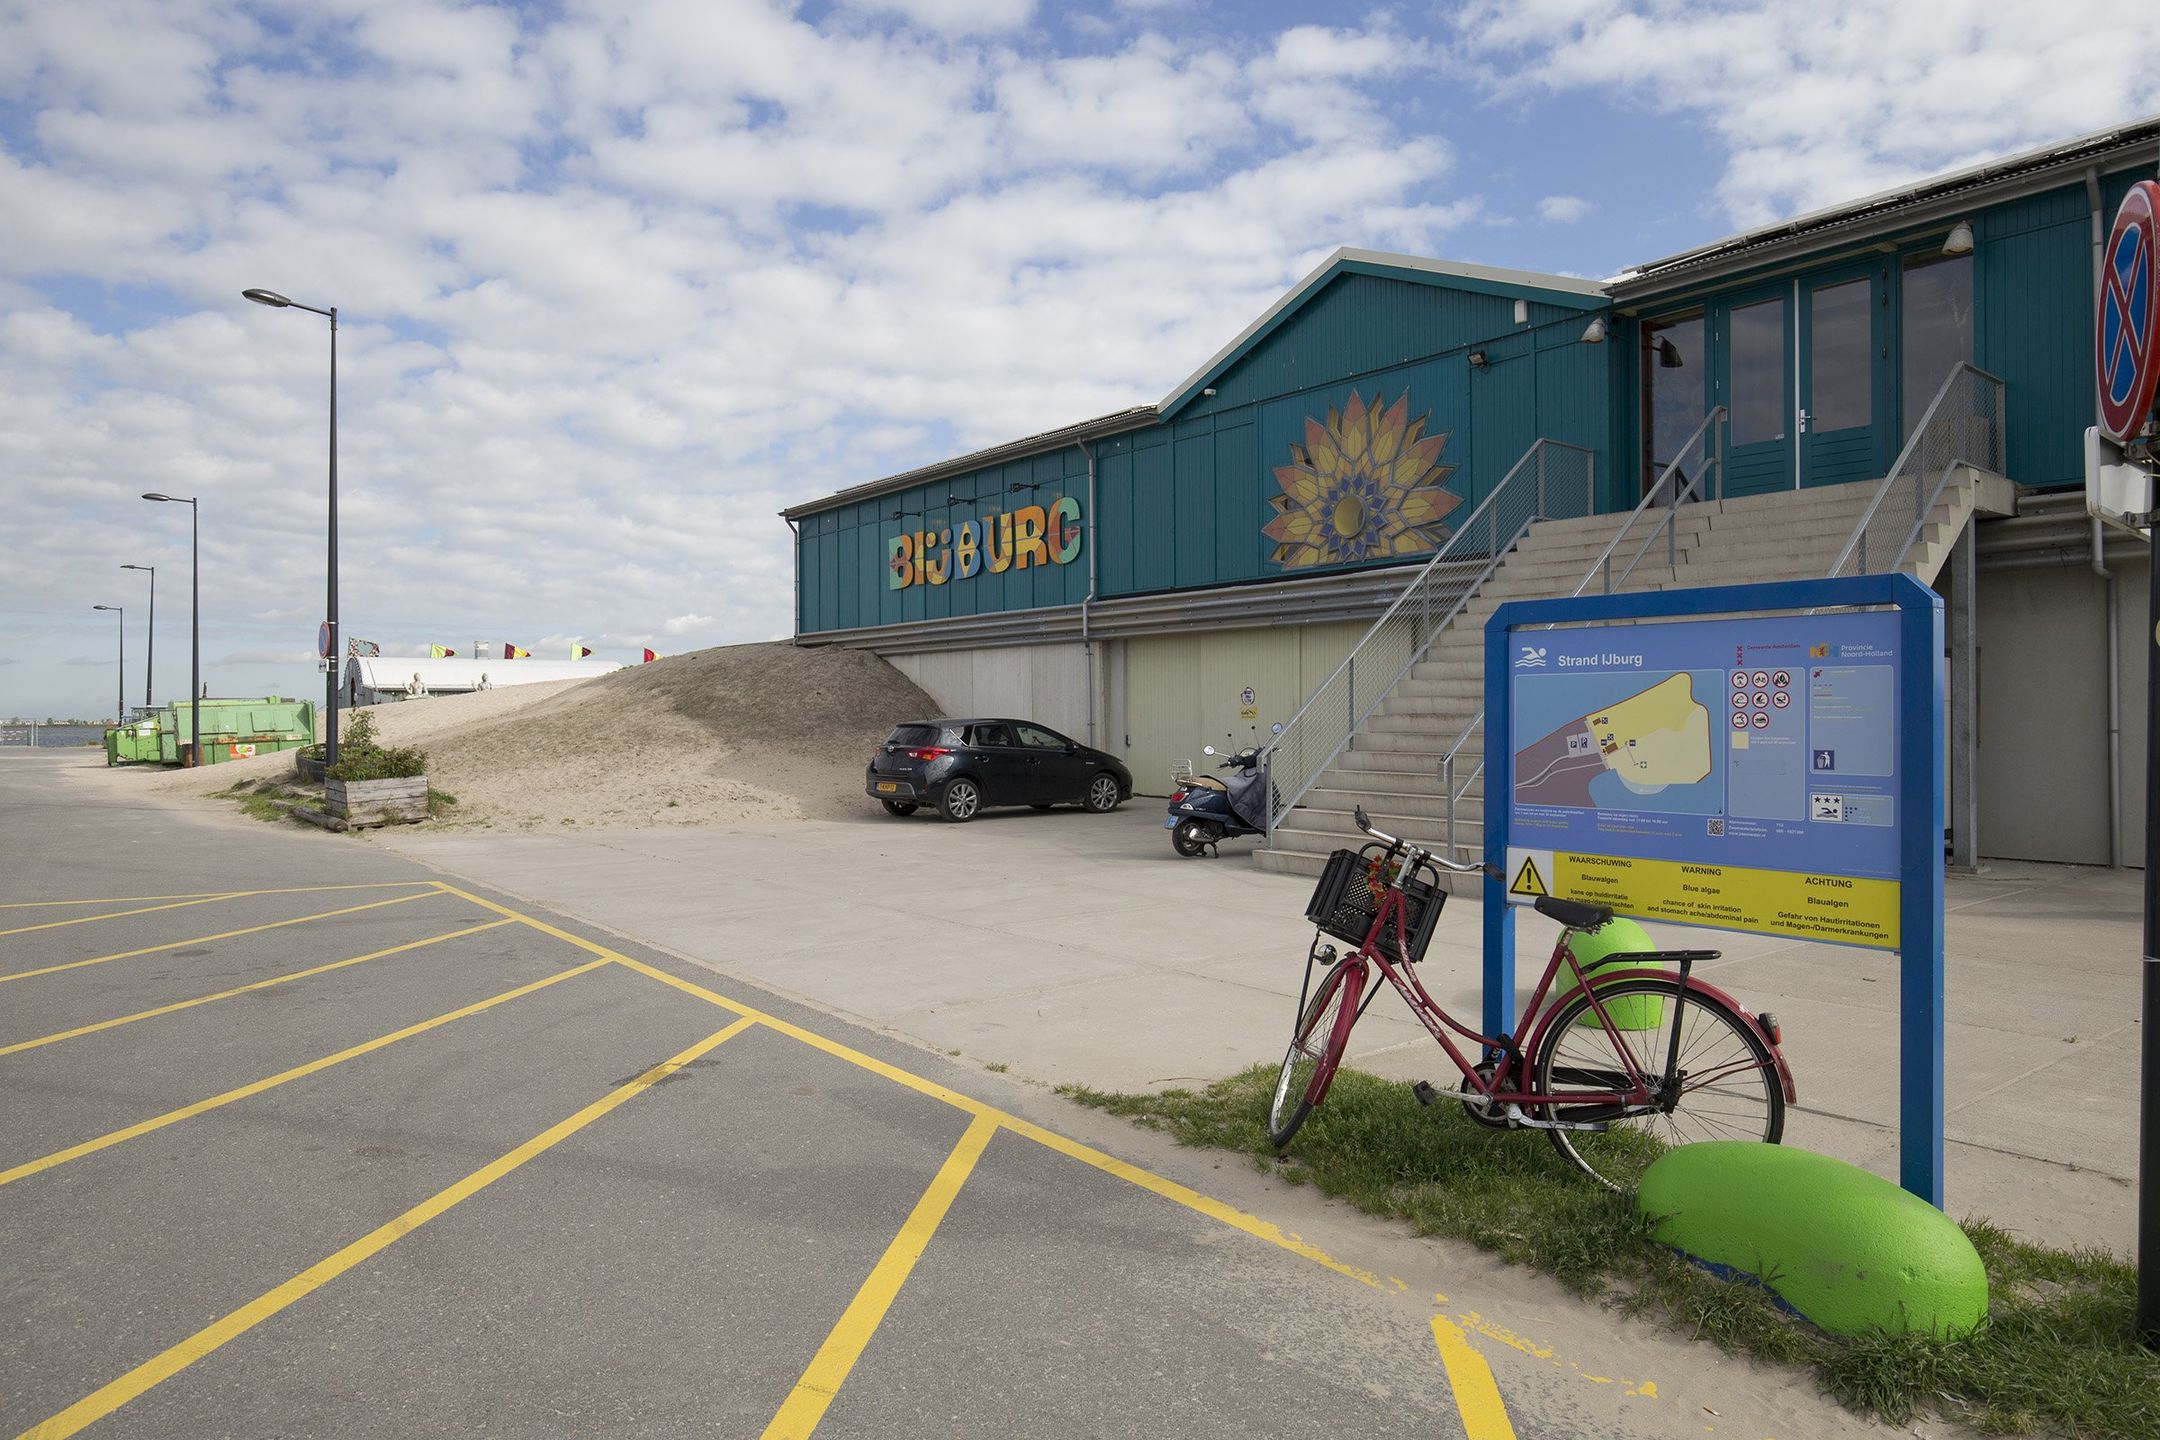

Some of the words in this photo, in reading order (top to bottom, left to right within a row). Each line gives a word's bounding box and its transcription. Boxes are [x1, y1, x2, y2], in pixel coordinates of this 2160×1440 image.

[1558, 654, 1598, 667] Strand
[1602, 653, 1643, 667] IJburg
[1569, 856, 1632, 868] WAARSCHUWING
[1682, 866, 1722, 876] WARNING
[1581, 874, 1618, 884] Blauwalgen
[1805, 877, 1853, 888] ACHTUNG
[1594, 890, 1629, 900] huidirritatie
[1683, 884, 1699, 892] Blue
[1701, 886, 1720, 895] algae
[1663, 899, 1685, 907] chance
[1697, 902, 1711, 910] skin
[1713, 904, 1742, 913] irritation
[1807, 897, 1849, 908] Blaualgen
[1660, 906, 1688, 916] stomach
[1689, 910, 1742, 922] ache/abdominal
[1743, 916, 1759, 924] pain
[1777, 911, 1802, 920] Gefahr
[1820, 916, 1880, 929] Hautirritationen
[1786, 921, 1889, 940] Magen-/Darmerkrankungen
